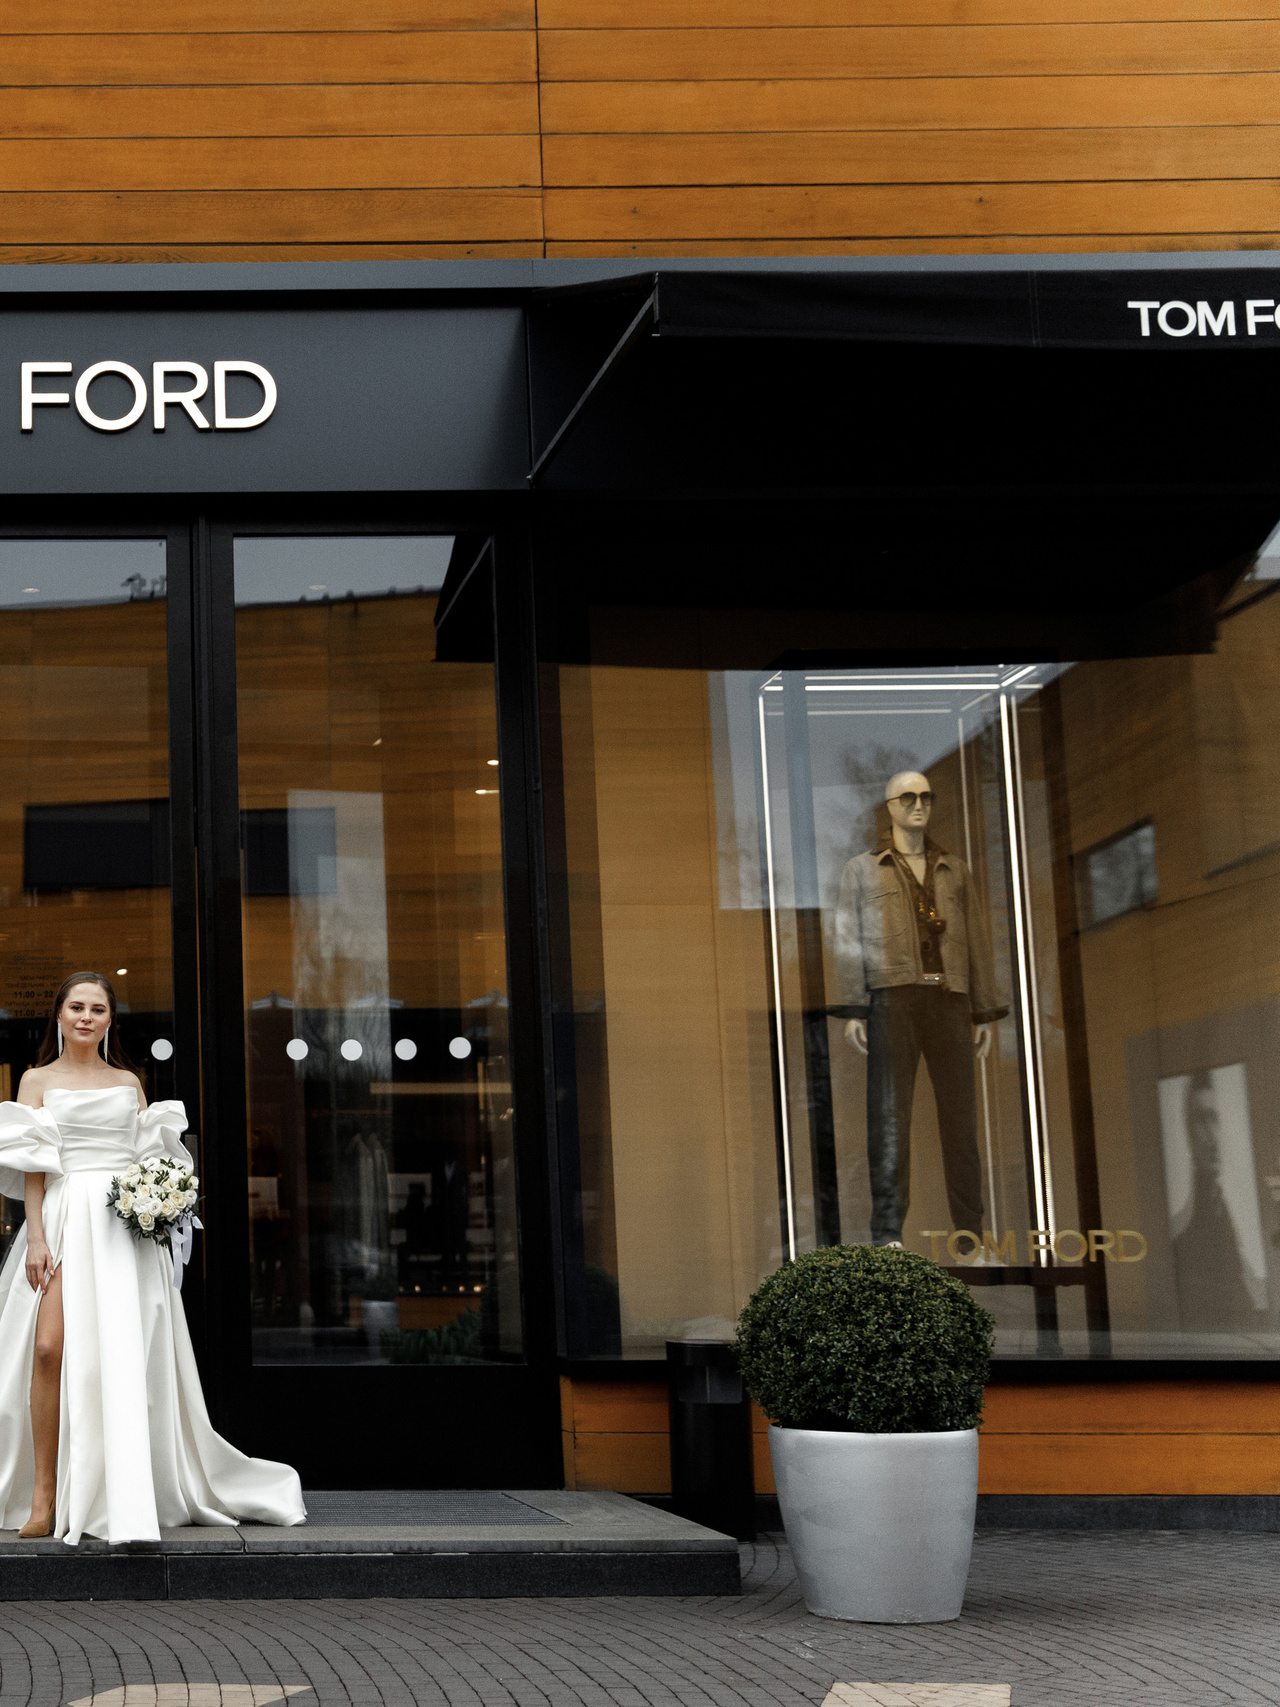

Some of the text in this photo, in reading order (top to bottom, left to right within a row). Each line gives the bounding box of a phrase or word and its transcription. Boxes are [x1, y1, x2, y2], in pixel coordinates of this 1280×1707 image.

[1127, 299, 1280, 337] TOM F
[20, 360, 278, 432] FORD
[13, 990, 35, 998] 11.00
[14, 1009, 35, 1017] 11.00
[920, 1229, 1148, 1263] TOM FORD
